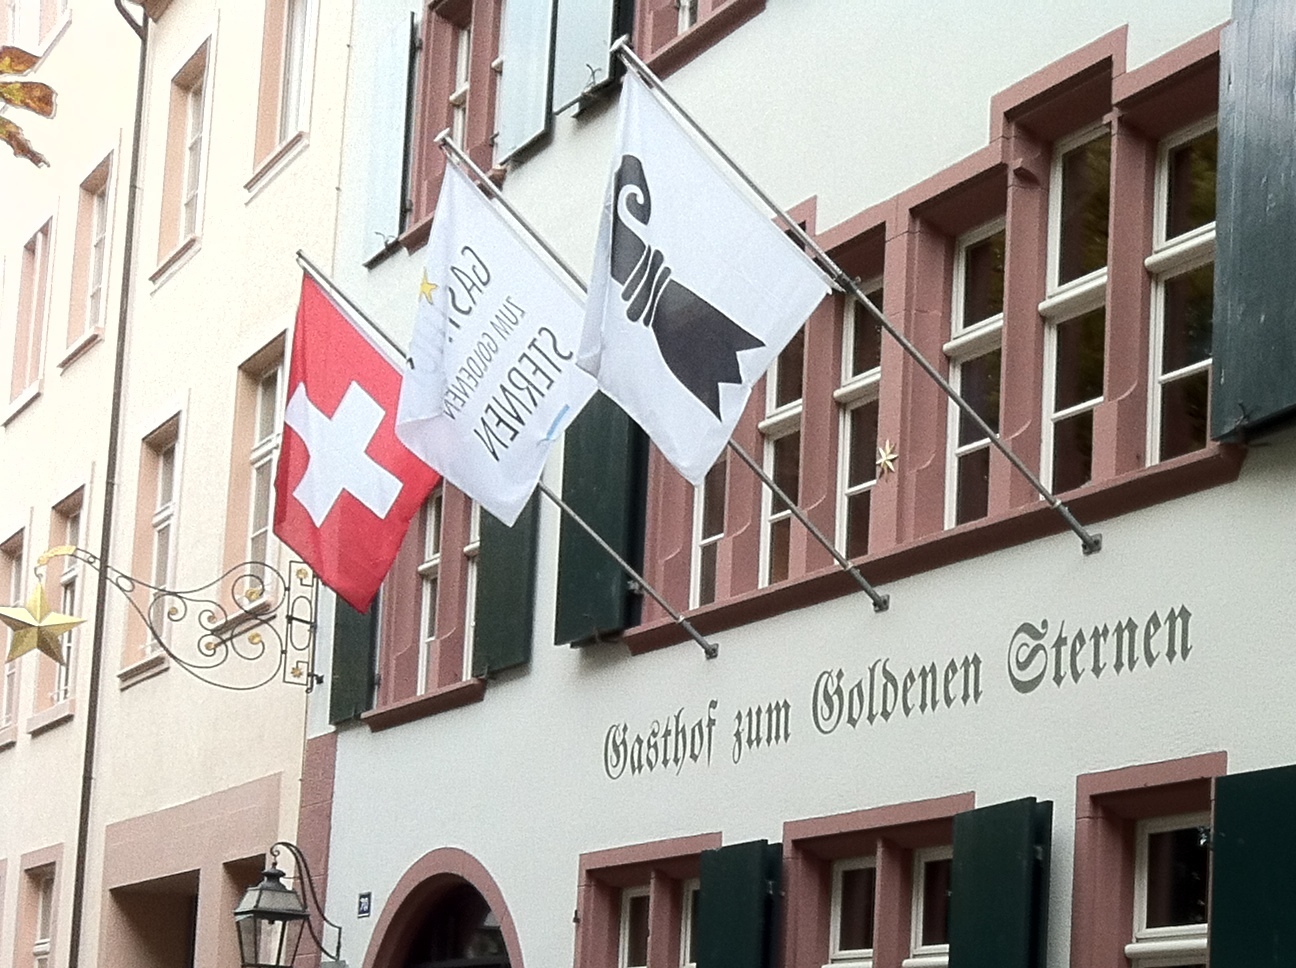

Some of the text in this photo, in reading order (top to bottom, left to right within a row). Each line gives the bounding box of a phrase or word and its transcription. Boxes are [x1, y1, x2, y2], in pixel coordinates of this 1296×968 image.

[603, 603, 1194, 780] Gasthof zum Goldenen Sternen
